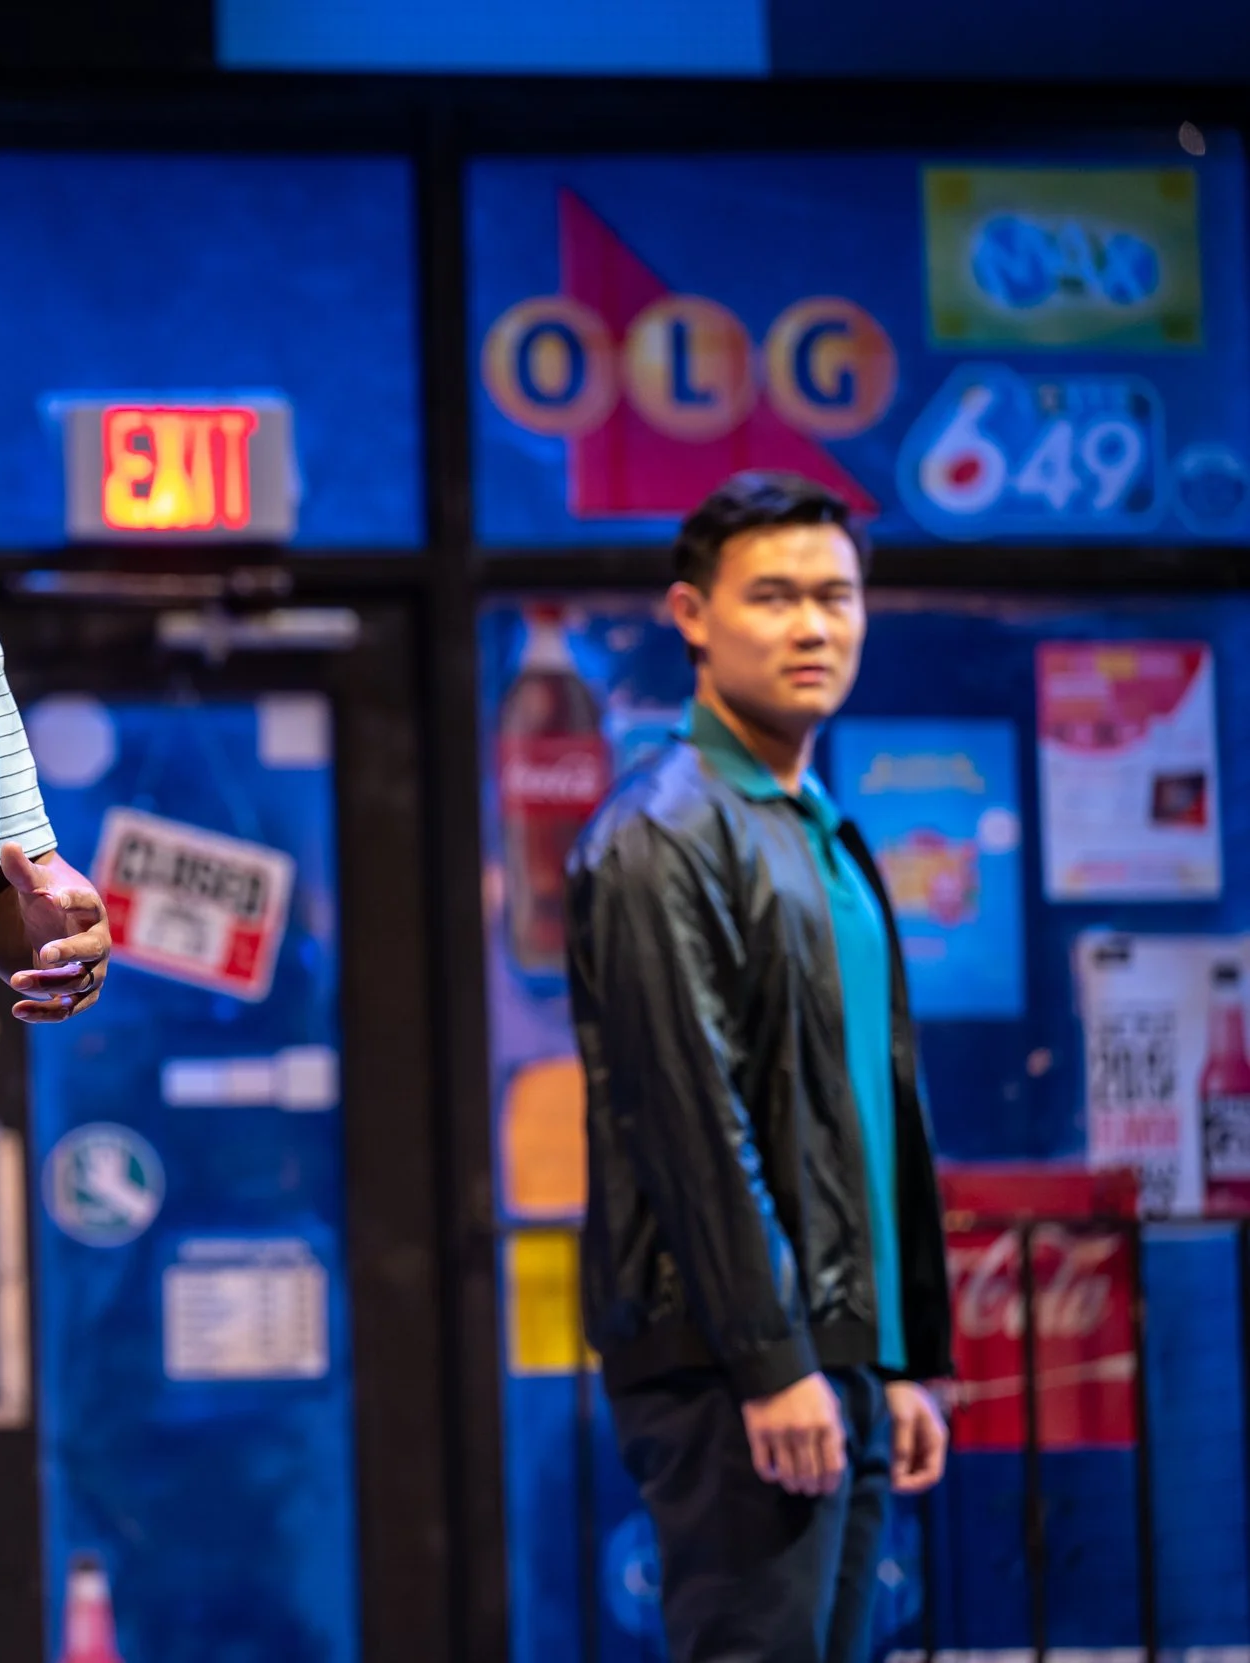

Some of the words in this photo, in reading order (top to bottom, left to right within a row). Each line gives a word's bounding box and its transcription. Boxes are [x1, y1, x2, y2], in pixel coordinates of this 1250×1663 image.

[514, 319, 862, 408] OLG
[102, 405, 258, 532] EXIT
[114, 831, 269, 919] CLOSED
